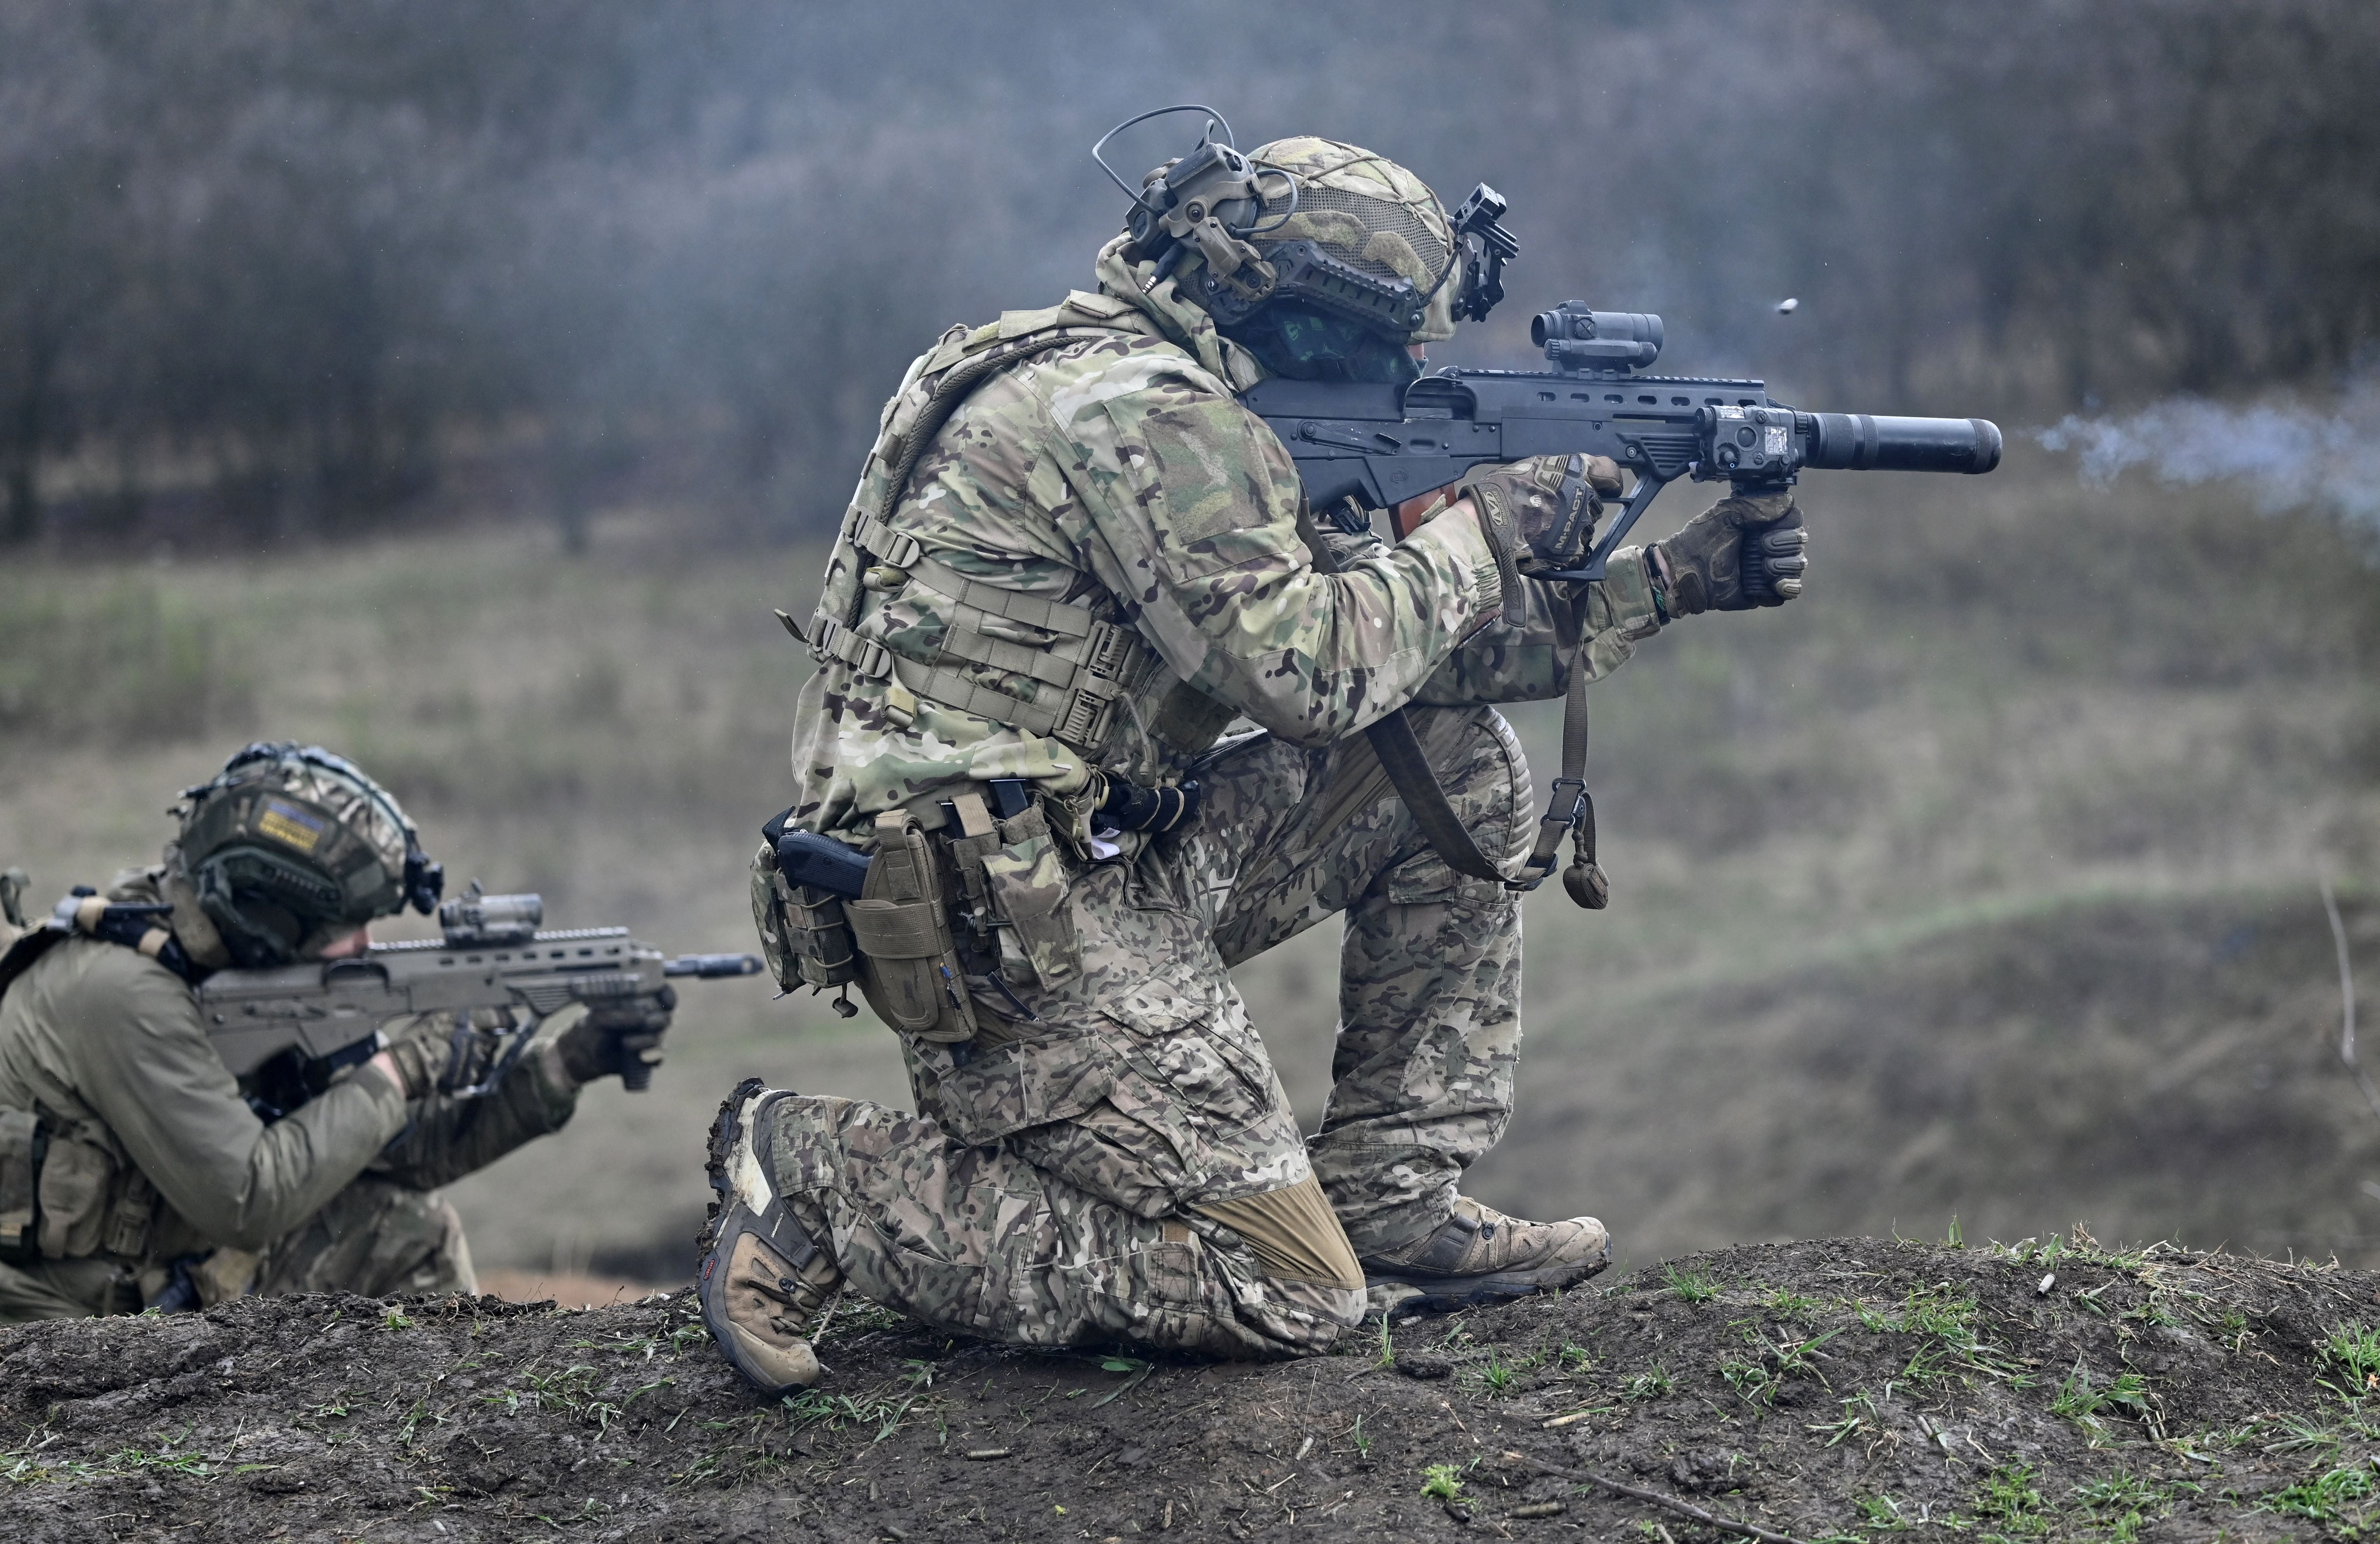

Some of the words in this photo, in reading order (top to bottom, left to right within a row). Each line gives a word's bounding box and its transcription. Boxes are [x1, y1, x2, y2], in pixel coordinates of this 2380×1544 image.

[1492, 491, 1501, 502] WEAR
[1499, 503, 1509, 526] MECHANIX
[1555, 488, 1582, 549] M-PACT
